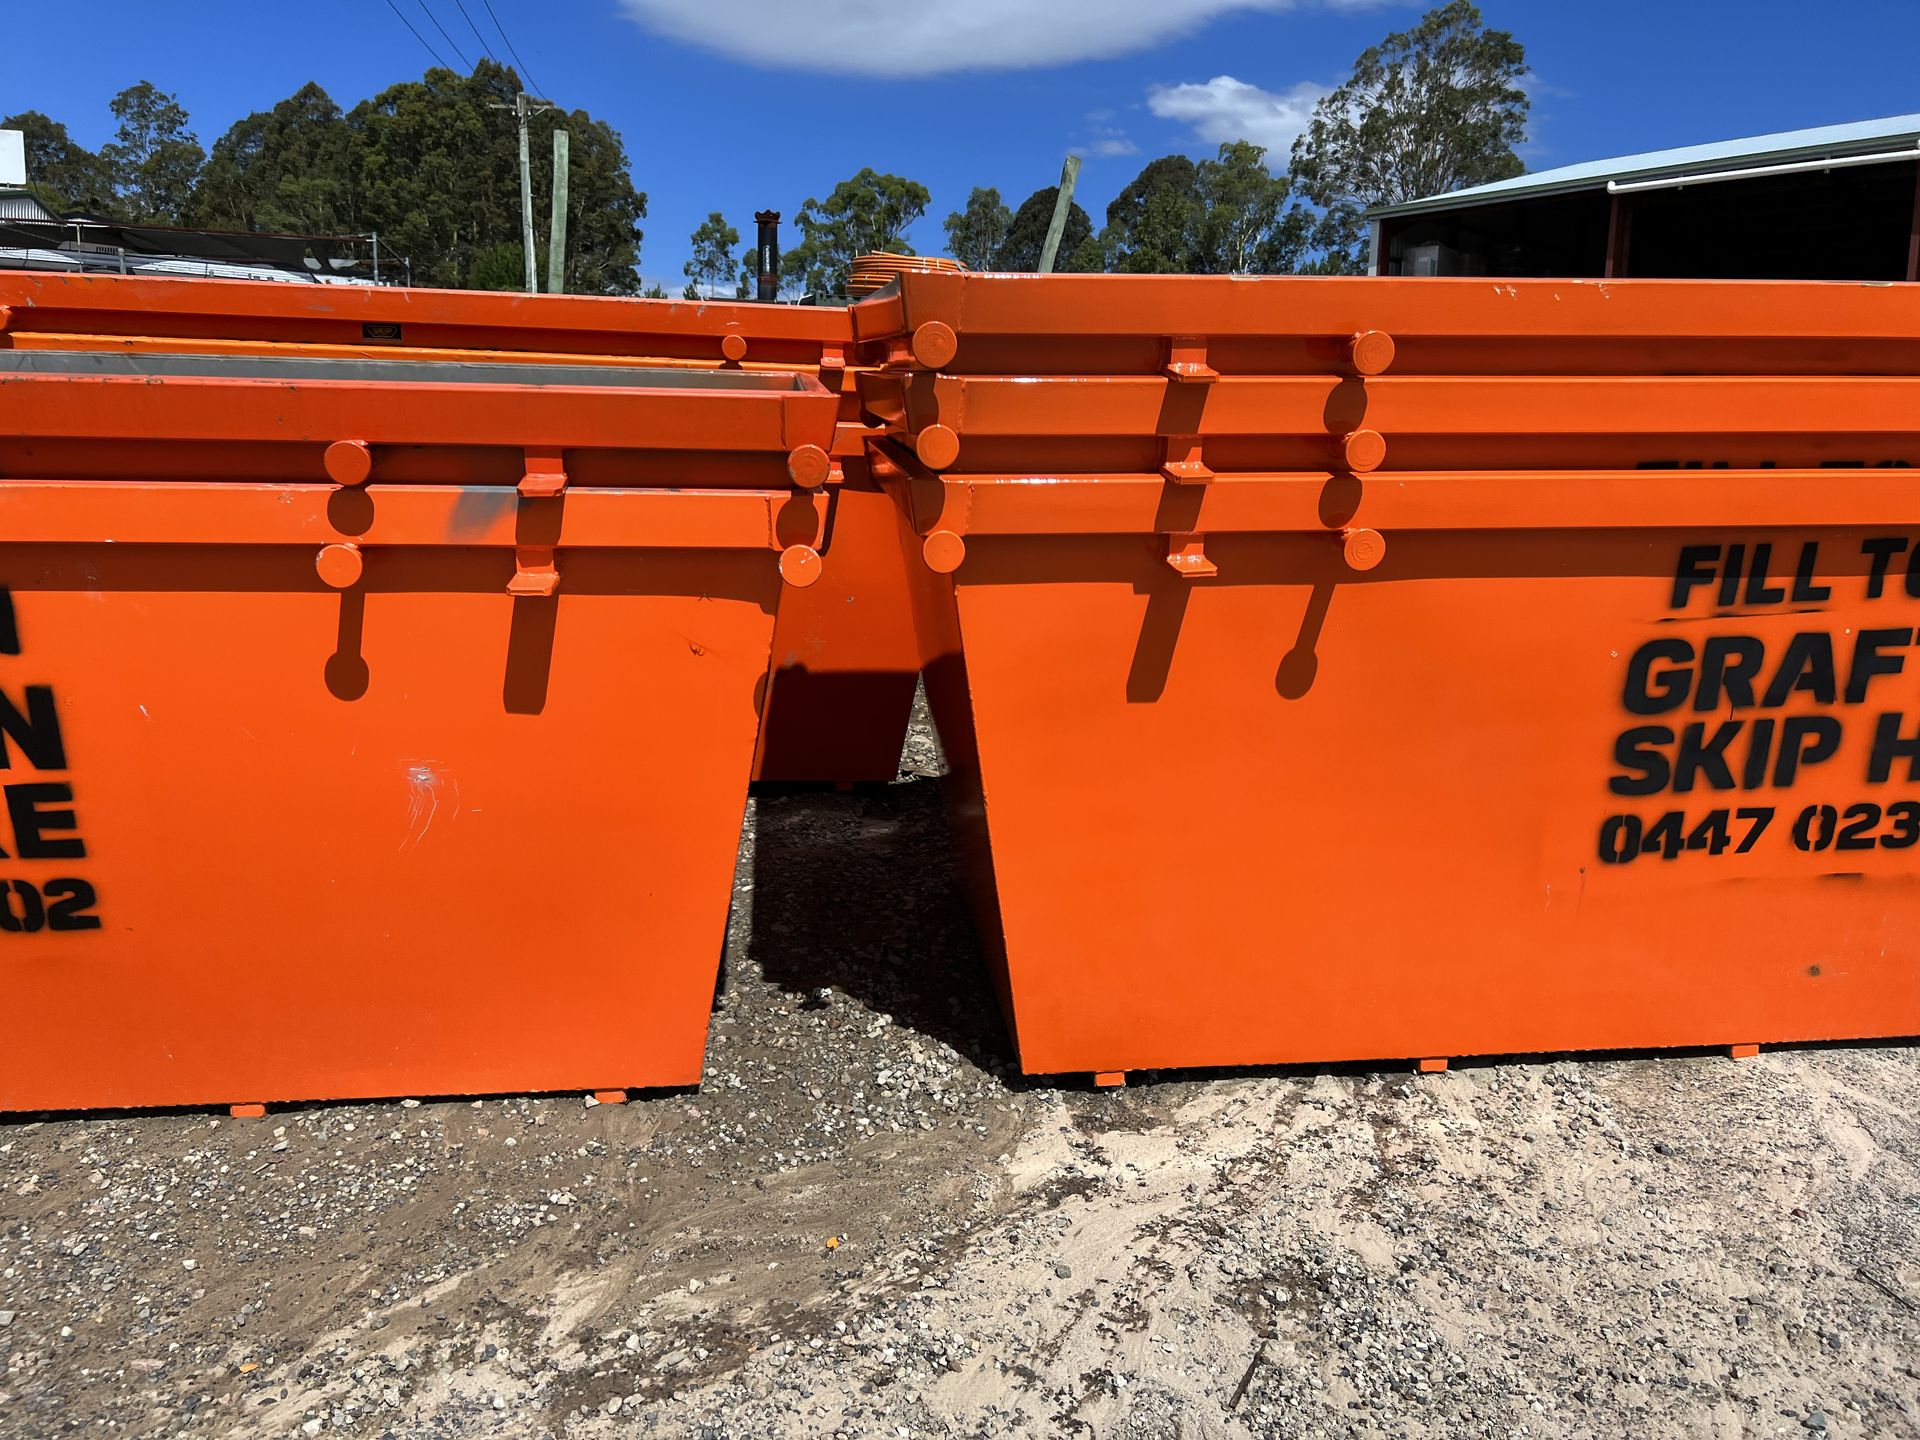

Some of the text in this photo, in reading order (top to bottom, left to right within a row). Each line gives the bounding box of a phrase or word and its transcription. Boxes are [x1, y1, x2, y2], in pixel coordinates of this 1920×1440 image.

[1670, 541, 1831, 609] FILL
[1622, 627, 1920, 716] GRAF
[1608, 716, 1843, 797] SKIP
[0, 782, 87, 859] E
[1598, 801, 1920, 864] 0447 023
